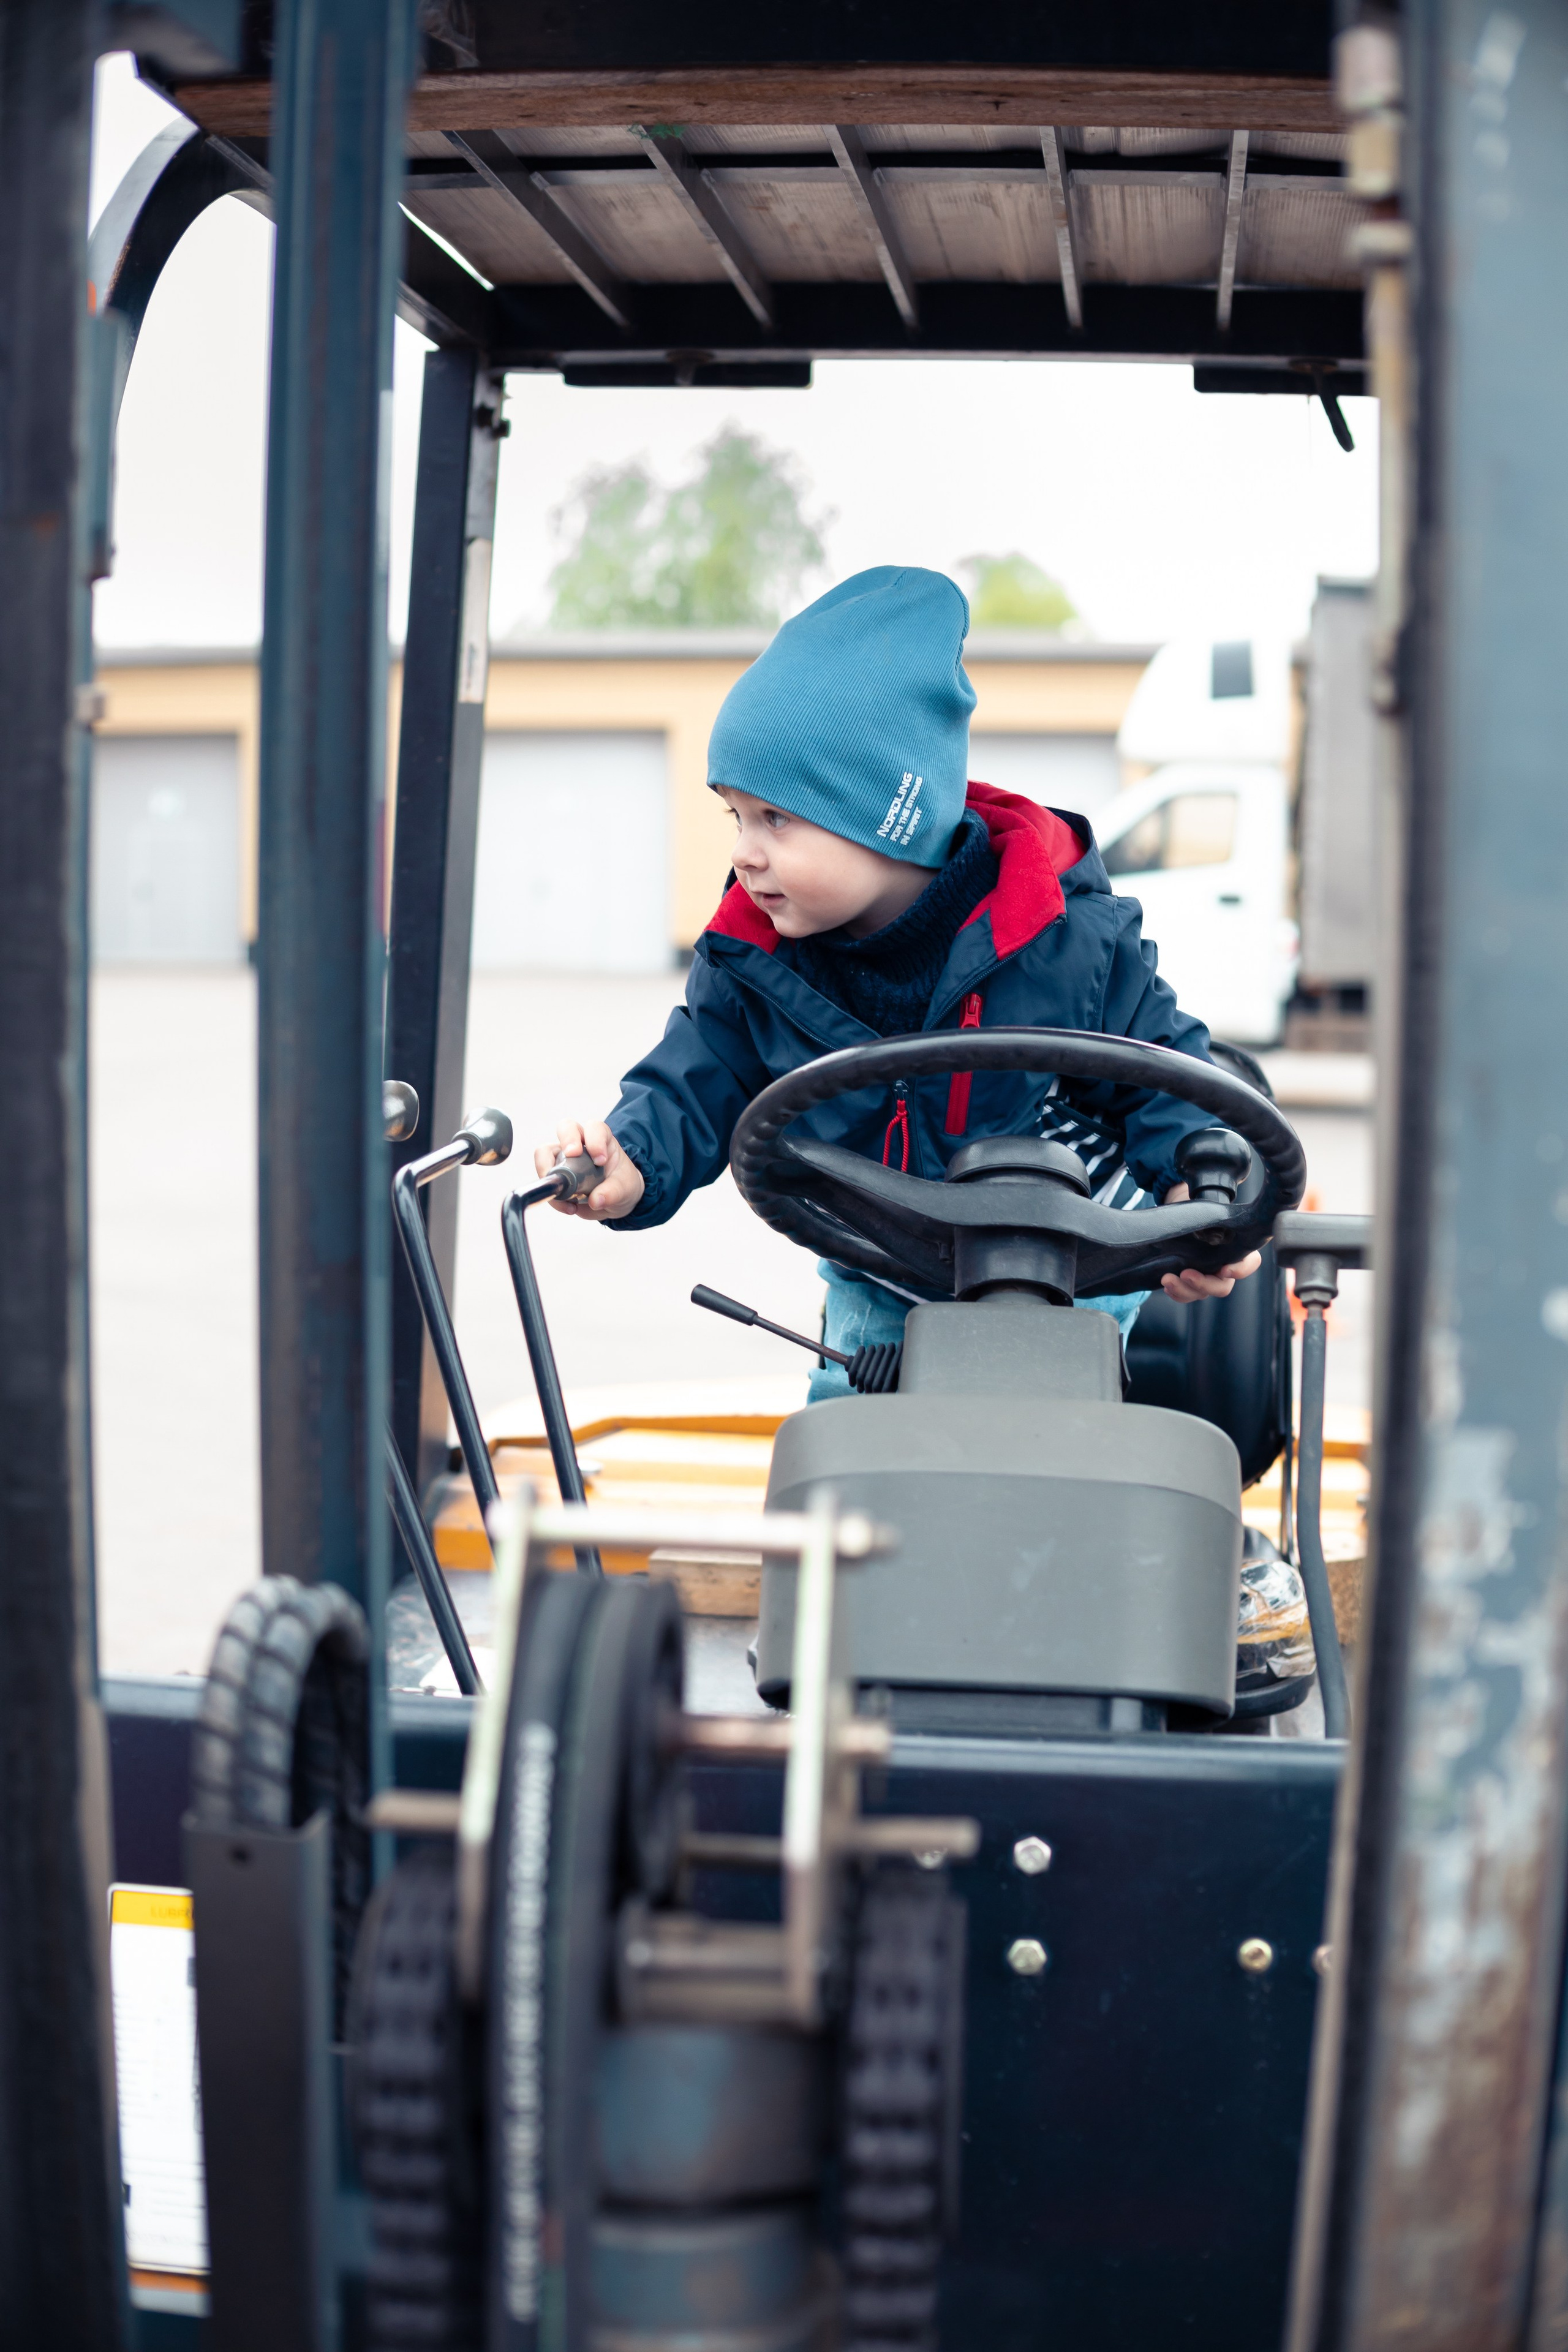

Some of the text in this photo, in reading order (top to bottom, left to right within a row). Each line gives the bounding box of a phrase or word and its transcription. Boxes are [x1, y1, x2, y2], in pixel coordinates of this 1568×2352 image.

[876, 772, 913, 837] NORDLING
[889, 776, 923, 842] FOR THE STRONG
[900, 806, 922, 845] IN SPIRIT
